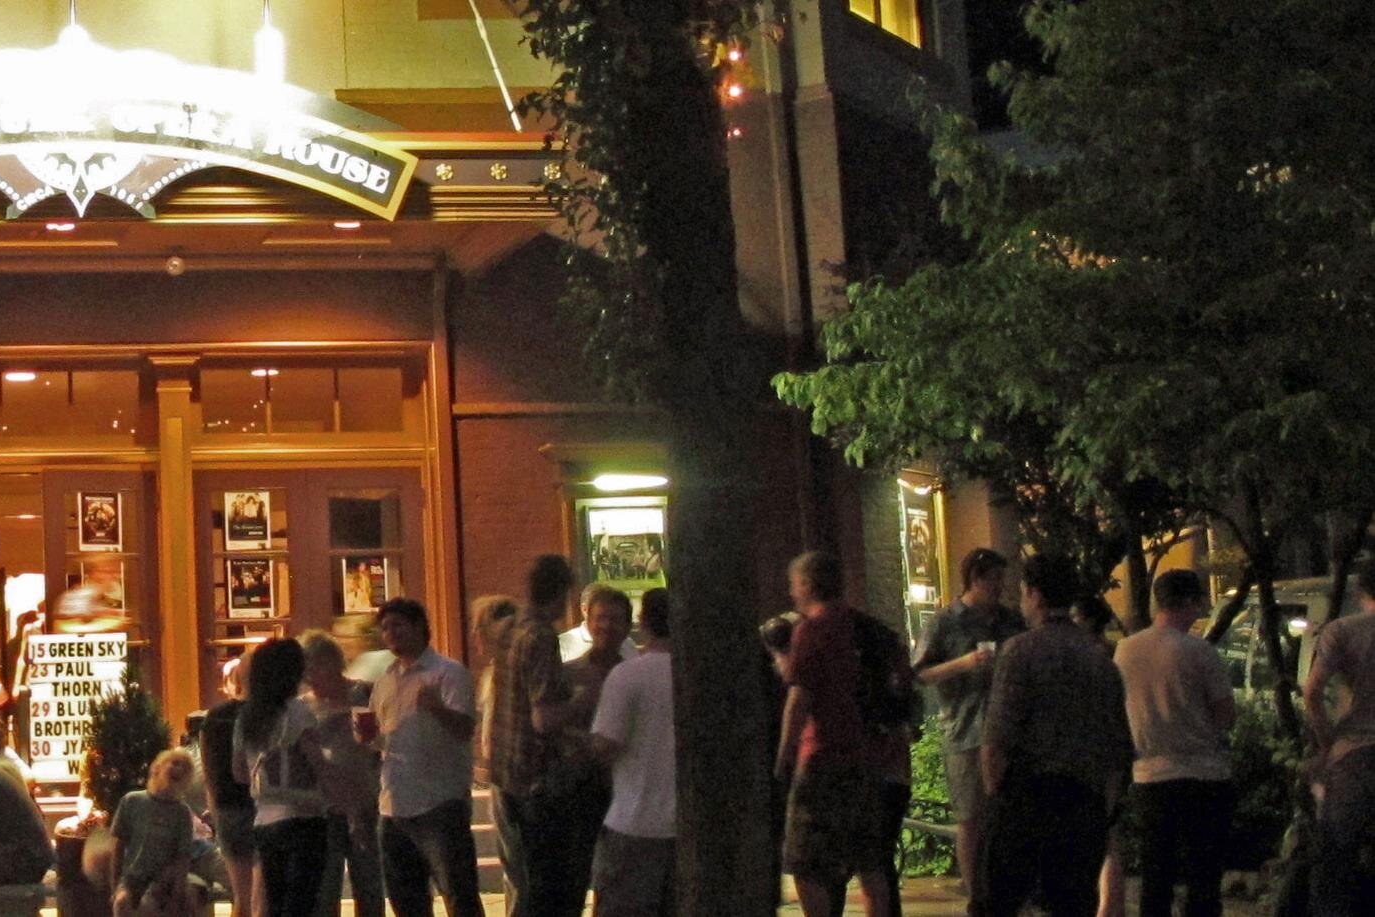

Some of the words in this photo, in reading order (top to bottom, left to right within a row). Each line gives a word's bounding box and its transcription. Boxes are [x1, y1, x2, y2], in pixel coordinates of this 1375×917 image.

[262, 126, 390, 194] HOUSE
[31, 643, 45, 659] 15
[49, 642, 94, 658] GREEN
[98, 641, 125, 657] SKY
[30, 663, 48, 678] 23
[55, 661, 94, 677] PAUL
[52, 681, 101, 697] THORN
[32, 702, 50, 717] 29
[32, 741, 50, 756] 30
